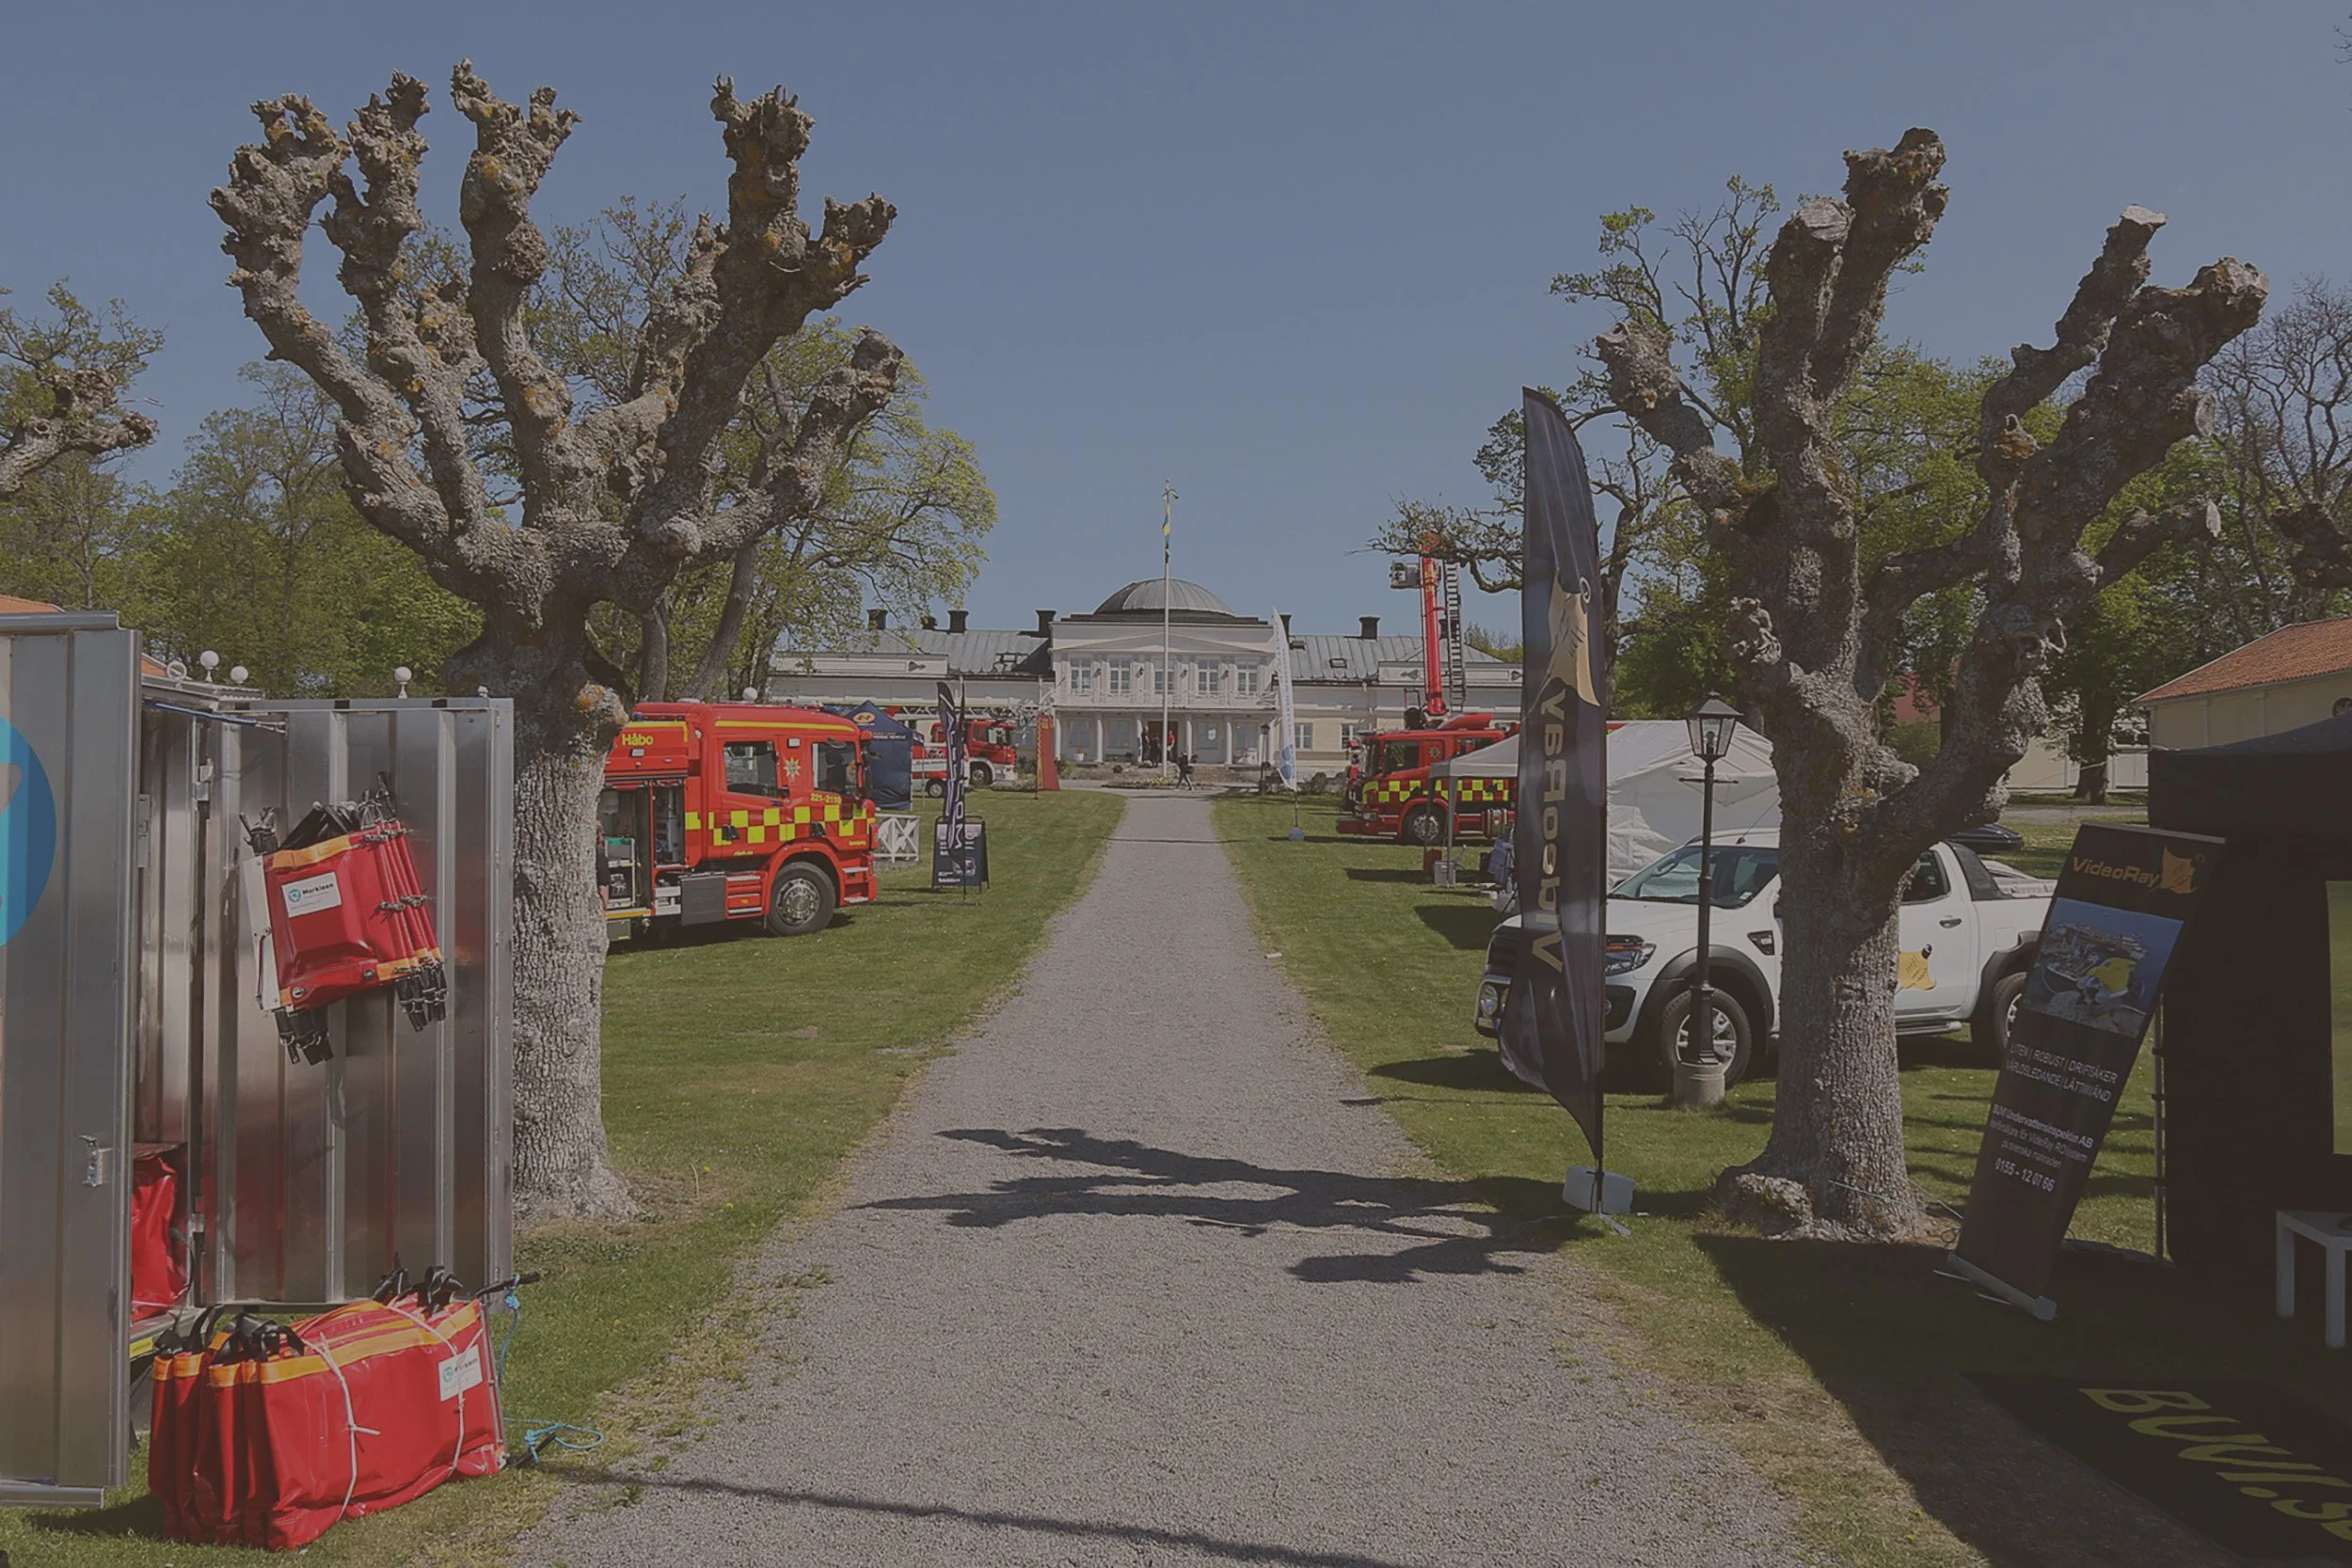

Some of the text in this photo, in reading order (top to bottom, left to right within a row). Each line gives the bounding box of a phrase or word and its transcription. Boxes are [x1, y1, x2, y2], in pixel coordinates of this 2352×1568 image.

[621, 733, 654, 746] Håbo
[2073, 856, 2160, 888] VideoRay
[2032, 1049, 2066, 1068] ROBUST
[2077, 1134, 2094, 1148] AB
